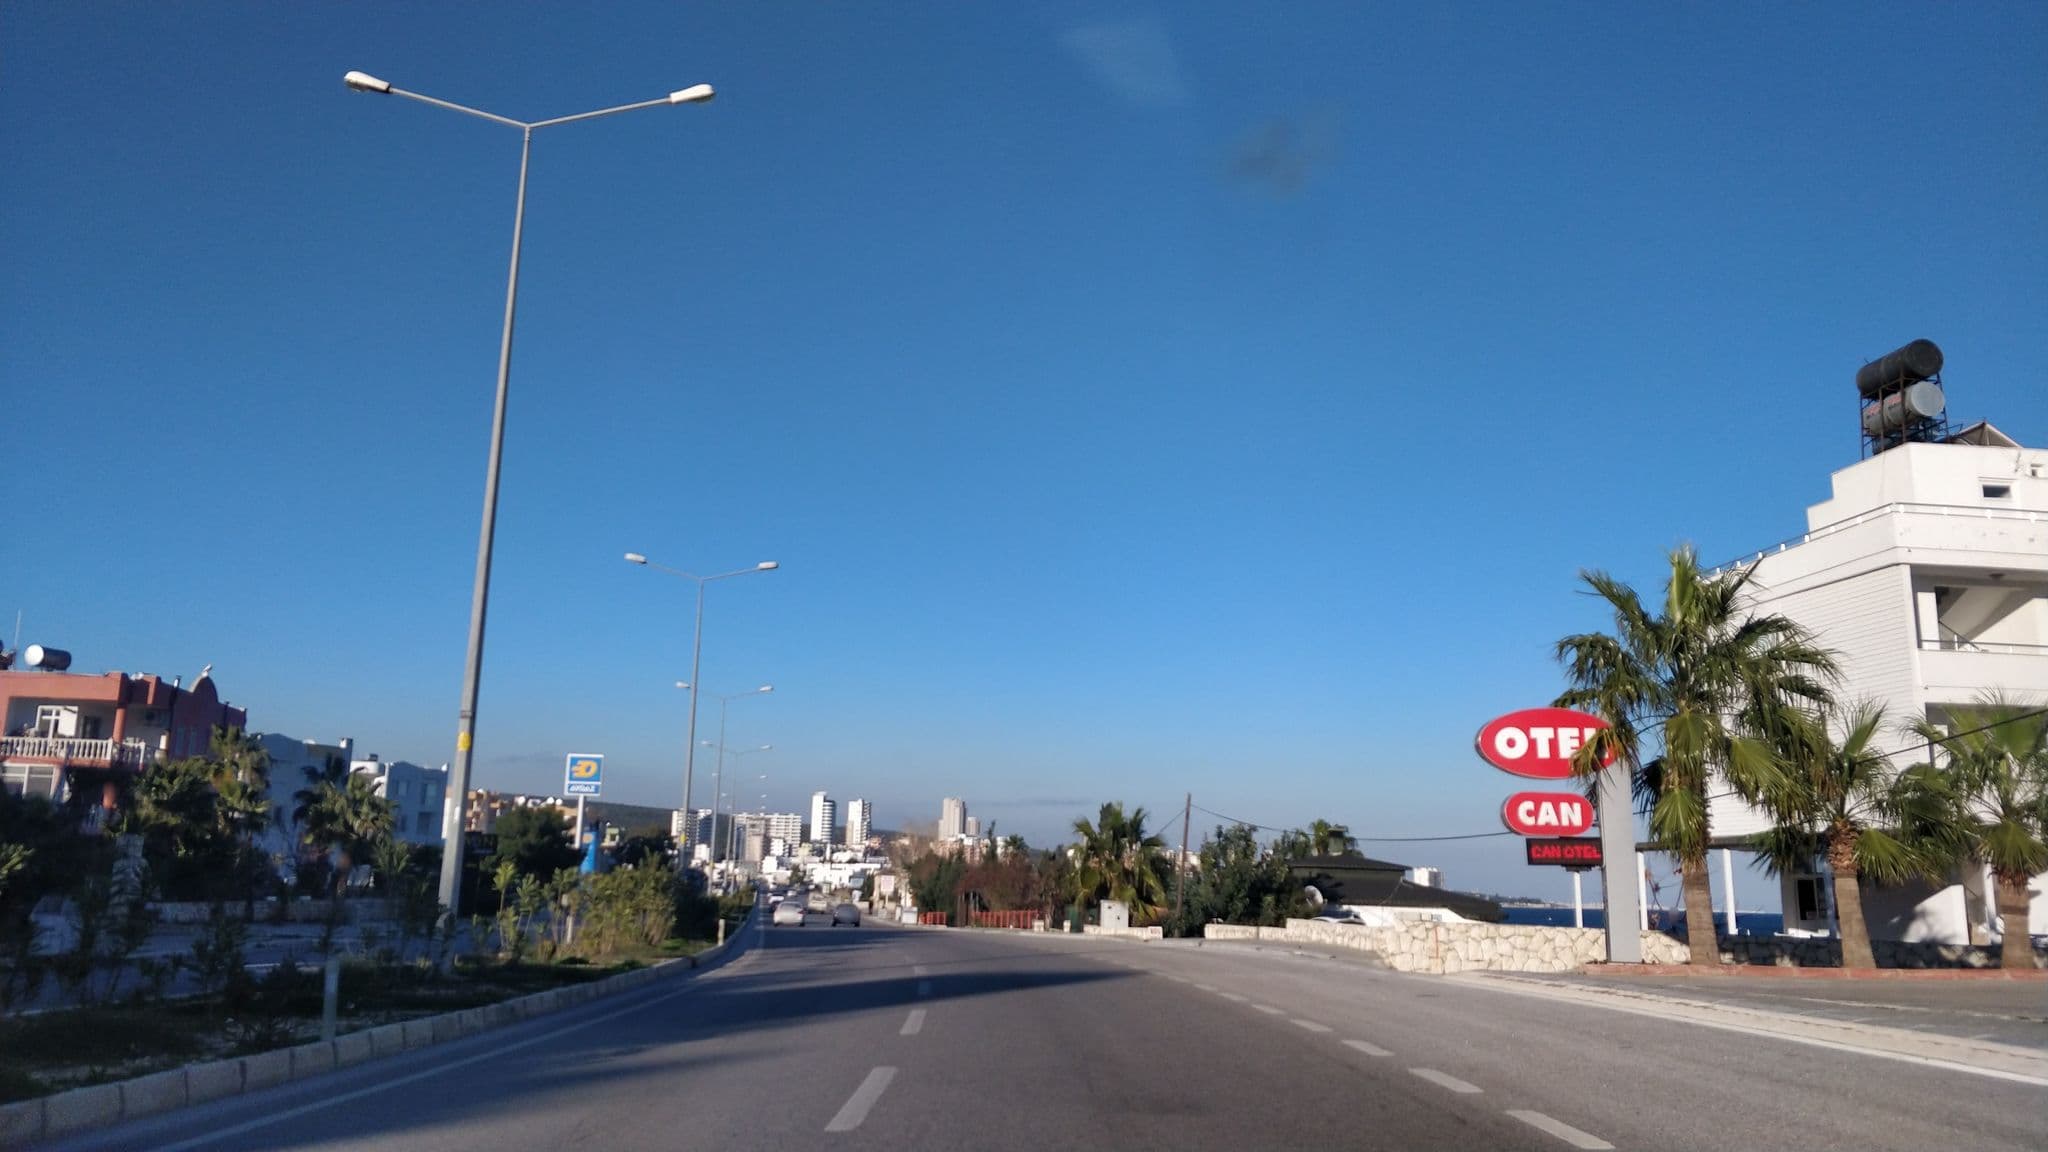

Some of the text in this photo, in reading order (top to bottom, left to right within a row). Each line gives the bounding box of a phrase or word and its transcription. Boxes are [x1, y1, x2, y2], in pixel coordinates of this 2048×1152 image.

[1517, 800, 1583, 827] CAN
[1531, 845, 1601, 859] CAN OTEL
